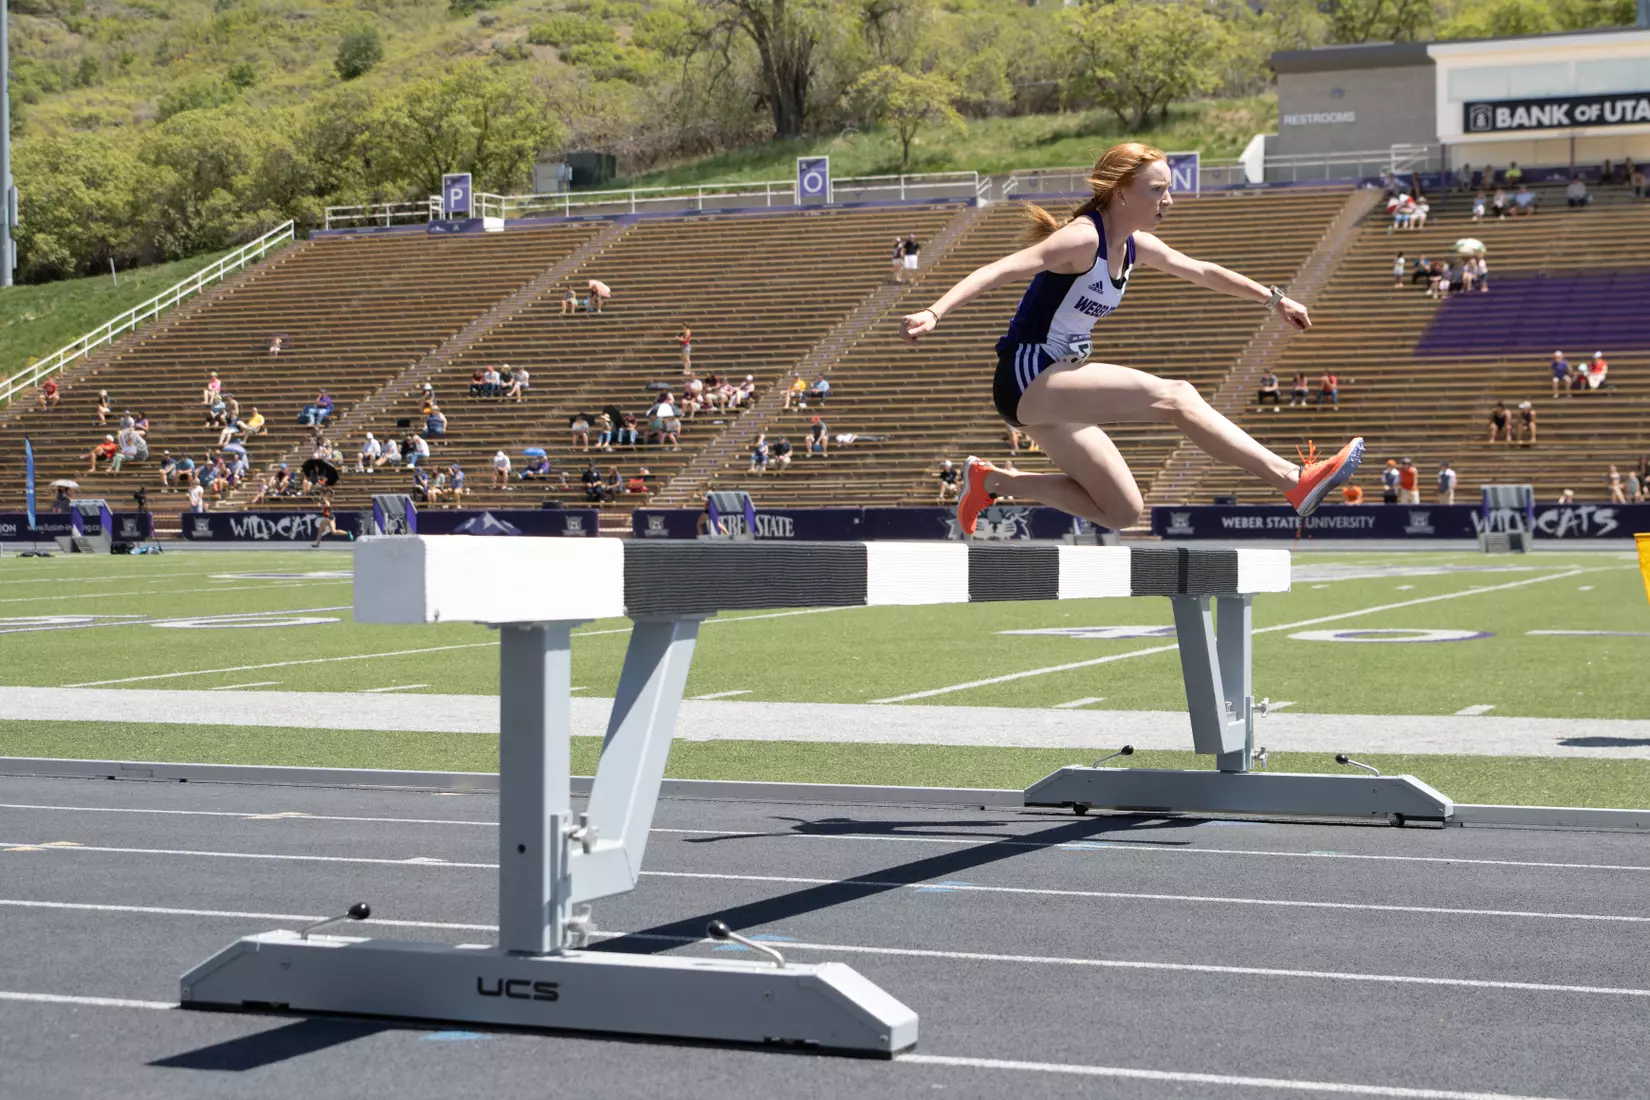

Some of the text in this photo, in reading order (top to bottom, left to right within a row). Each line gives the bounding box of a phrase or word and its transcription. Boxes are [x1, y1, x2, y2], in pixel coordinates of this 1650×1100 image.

[1283, 111, 1355, 126] RESTROOMS
[1495, 104, 1571, 129] BANK
[1574, 104, 1602, 122] OF
[1171, 167, 1191, 190] N
[450, 188, 463, 209] P
[755, 514, 795, 537] STATE
[1221, 516, 1376, 528] WEBER STATE UNIVERSITY
[477, 976, 560, 1002] UCS
